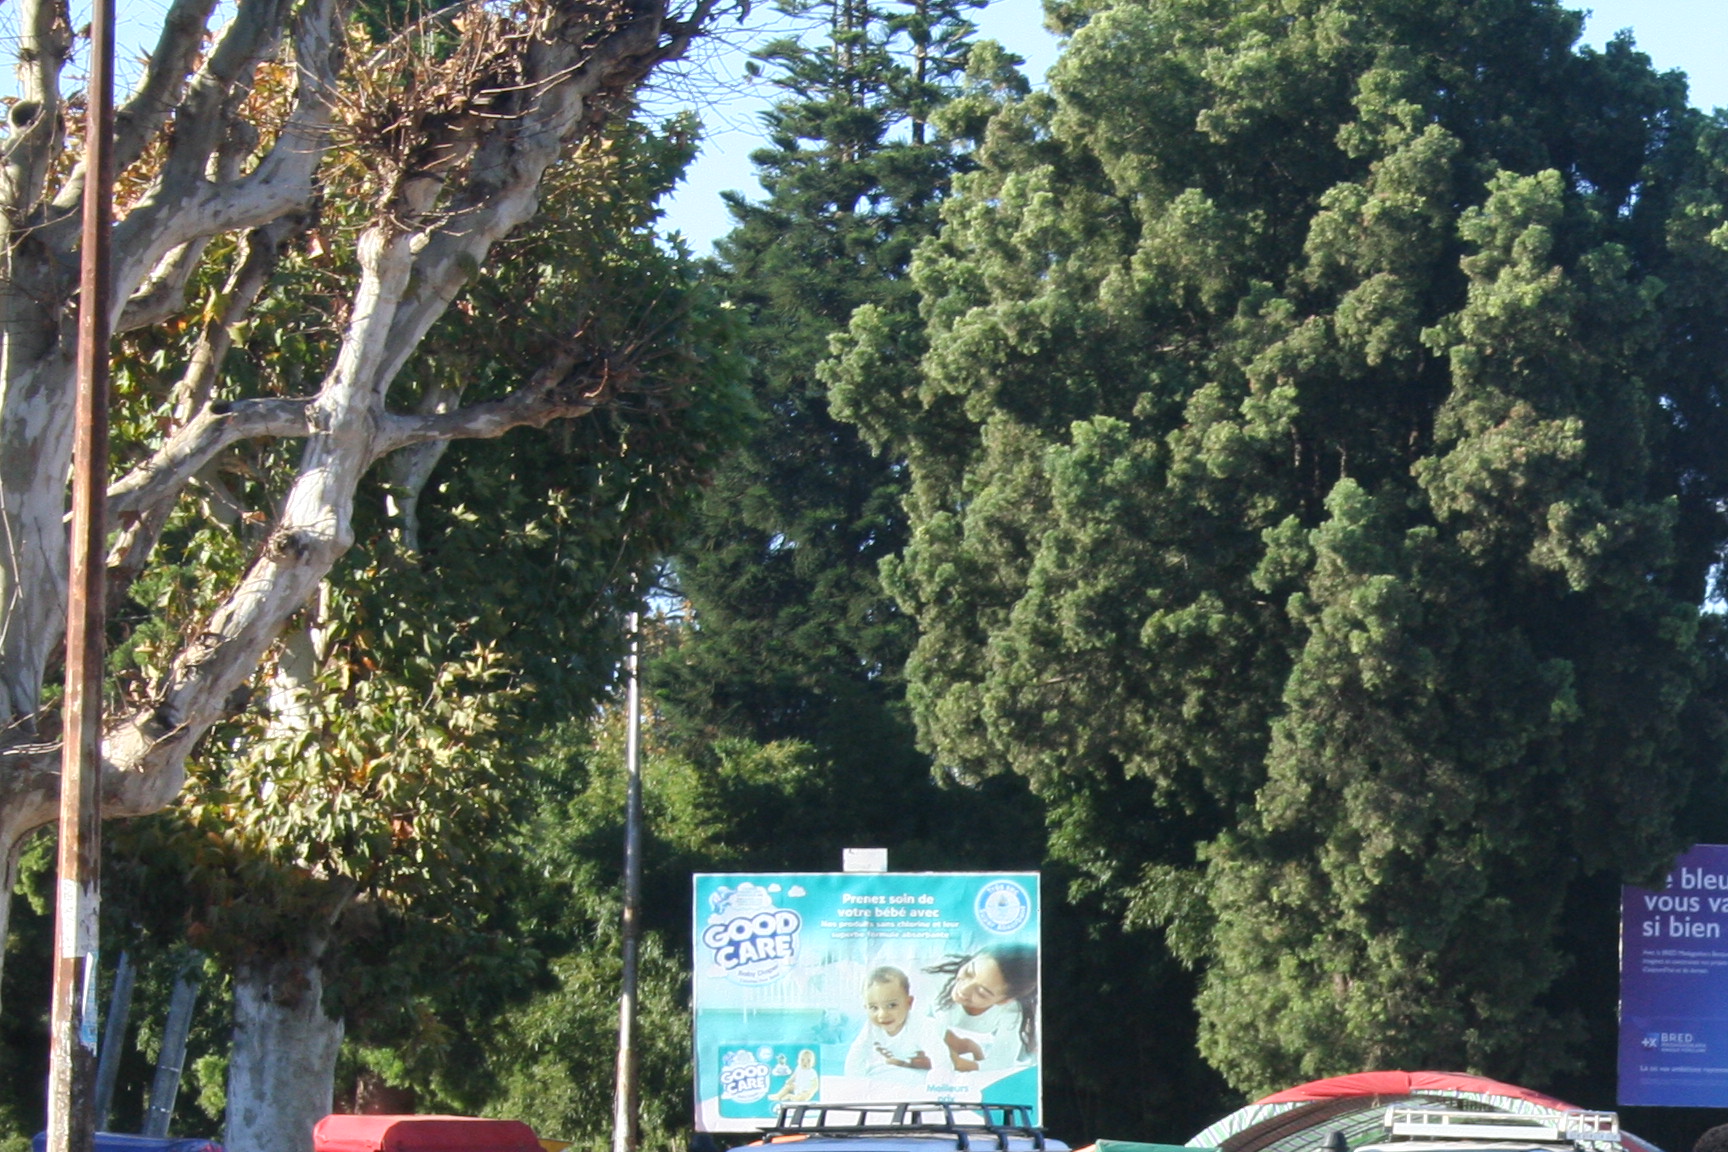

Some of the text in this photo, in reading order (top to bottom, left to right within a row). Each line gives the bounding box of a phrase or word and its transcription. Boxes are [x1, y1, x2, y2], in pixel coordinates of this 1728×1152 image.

[842, 893, 934, 904] Prenez soin de
[1644, 895, 1700, 912] vous
[837, 906, 939, 918] votre bébé avec
[703, 910, 800, 949] GOOD
[1642, 915, 1721, 938] si bien
[715, 934, 793, 970] CARE
[1661, 1033, 1693, 1043] BRED
[720, 1064, 769, 1084] GOOD
[726, 1076, 765, 1094] CARE
